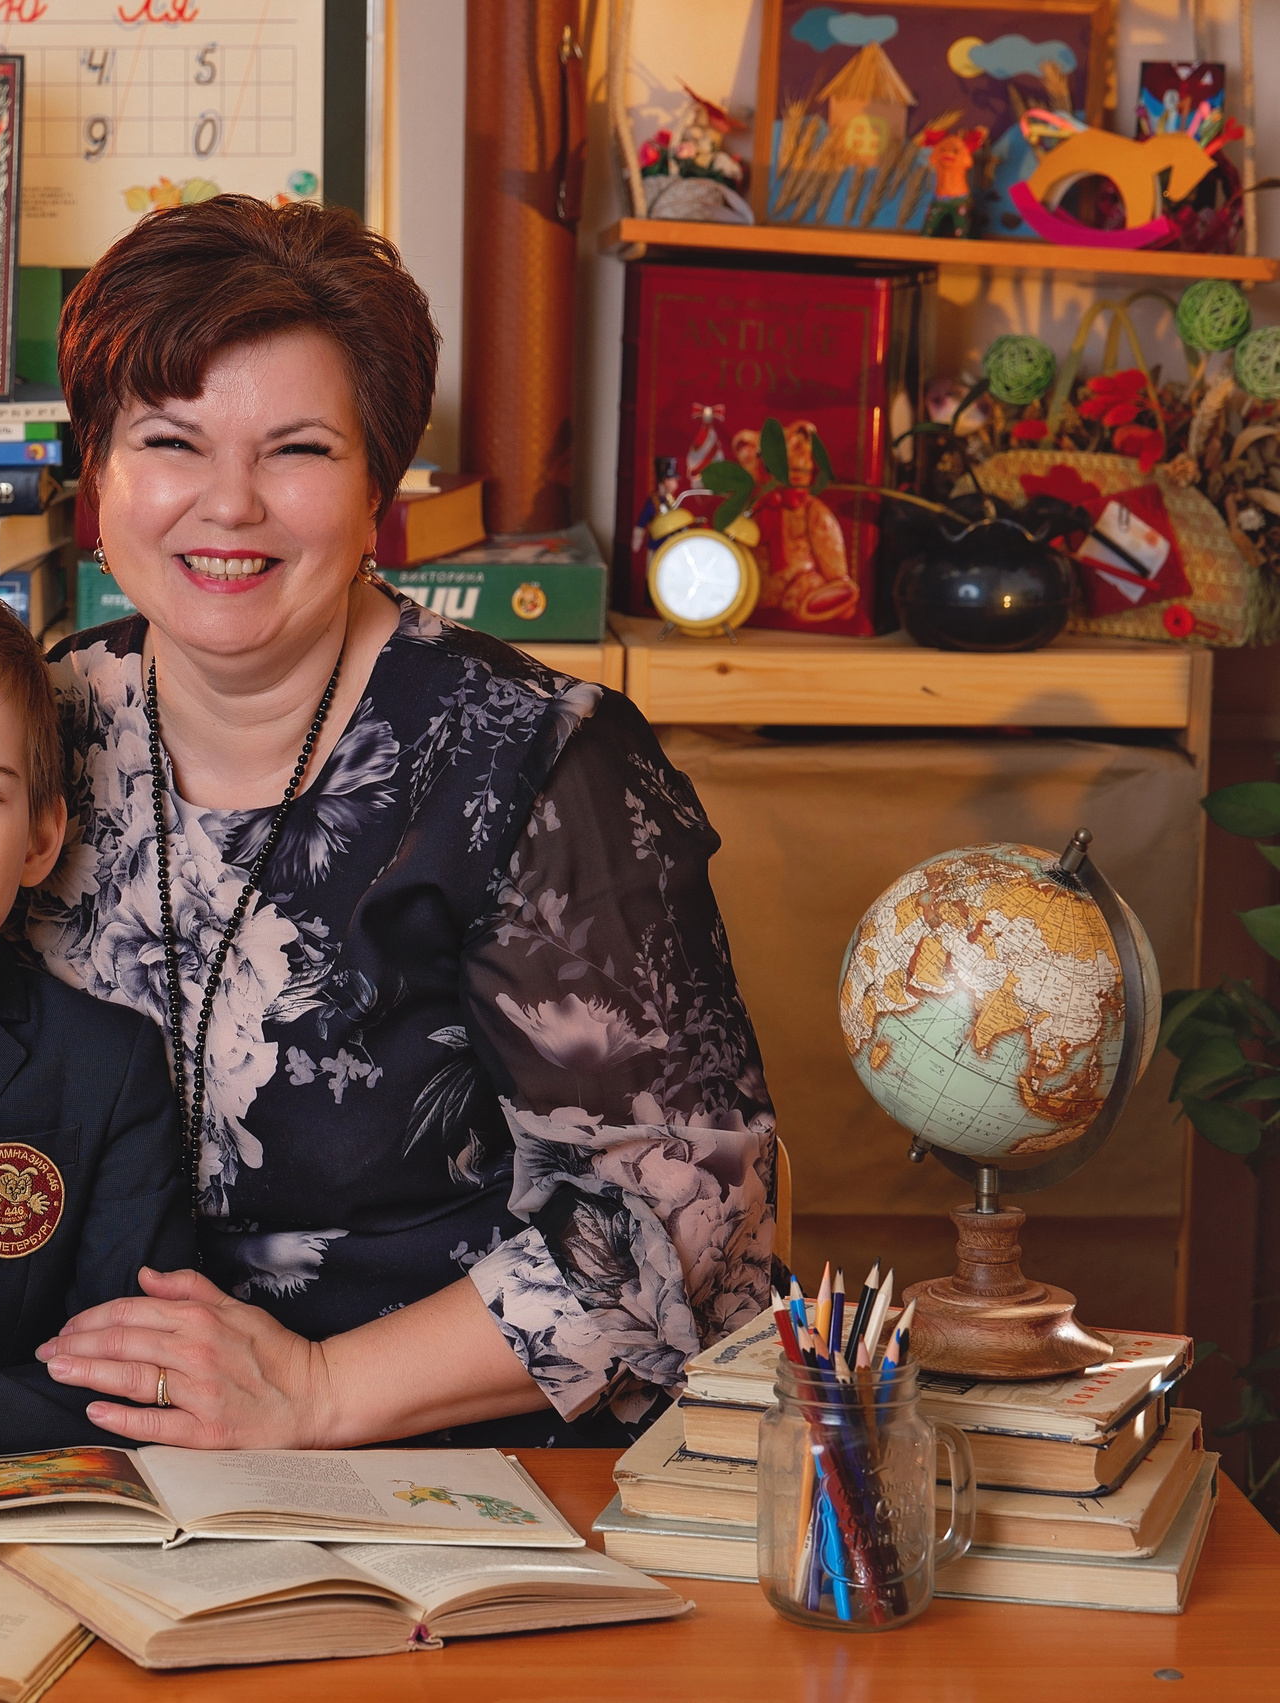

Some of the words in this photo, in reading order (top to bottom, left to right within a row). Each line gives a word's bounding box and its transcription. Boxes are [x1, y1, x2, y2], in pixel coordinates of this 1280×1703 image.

[87, 48, 109, 85] 4
[194, 46, 218, 86] 5
[84, 116, 109, 158] 9
[193, 116, 219, 158] 0
[680, 318, 839, 360] ANTIQUE
[711, 358, 802, 395] TOYS
[398, 570, 485, 584] ВИКТОРИНА
[46, 1171, 60, 1192] 446
[4, 1205, 25, 1217] 446
[1066, 1350, 1144, 1406] САХАРНОВ
